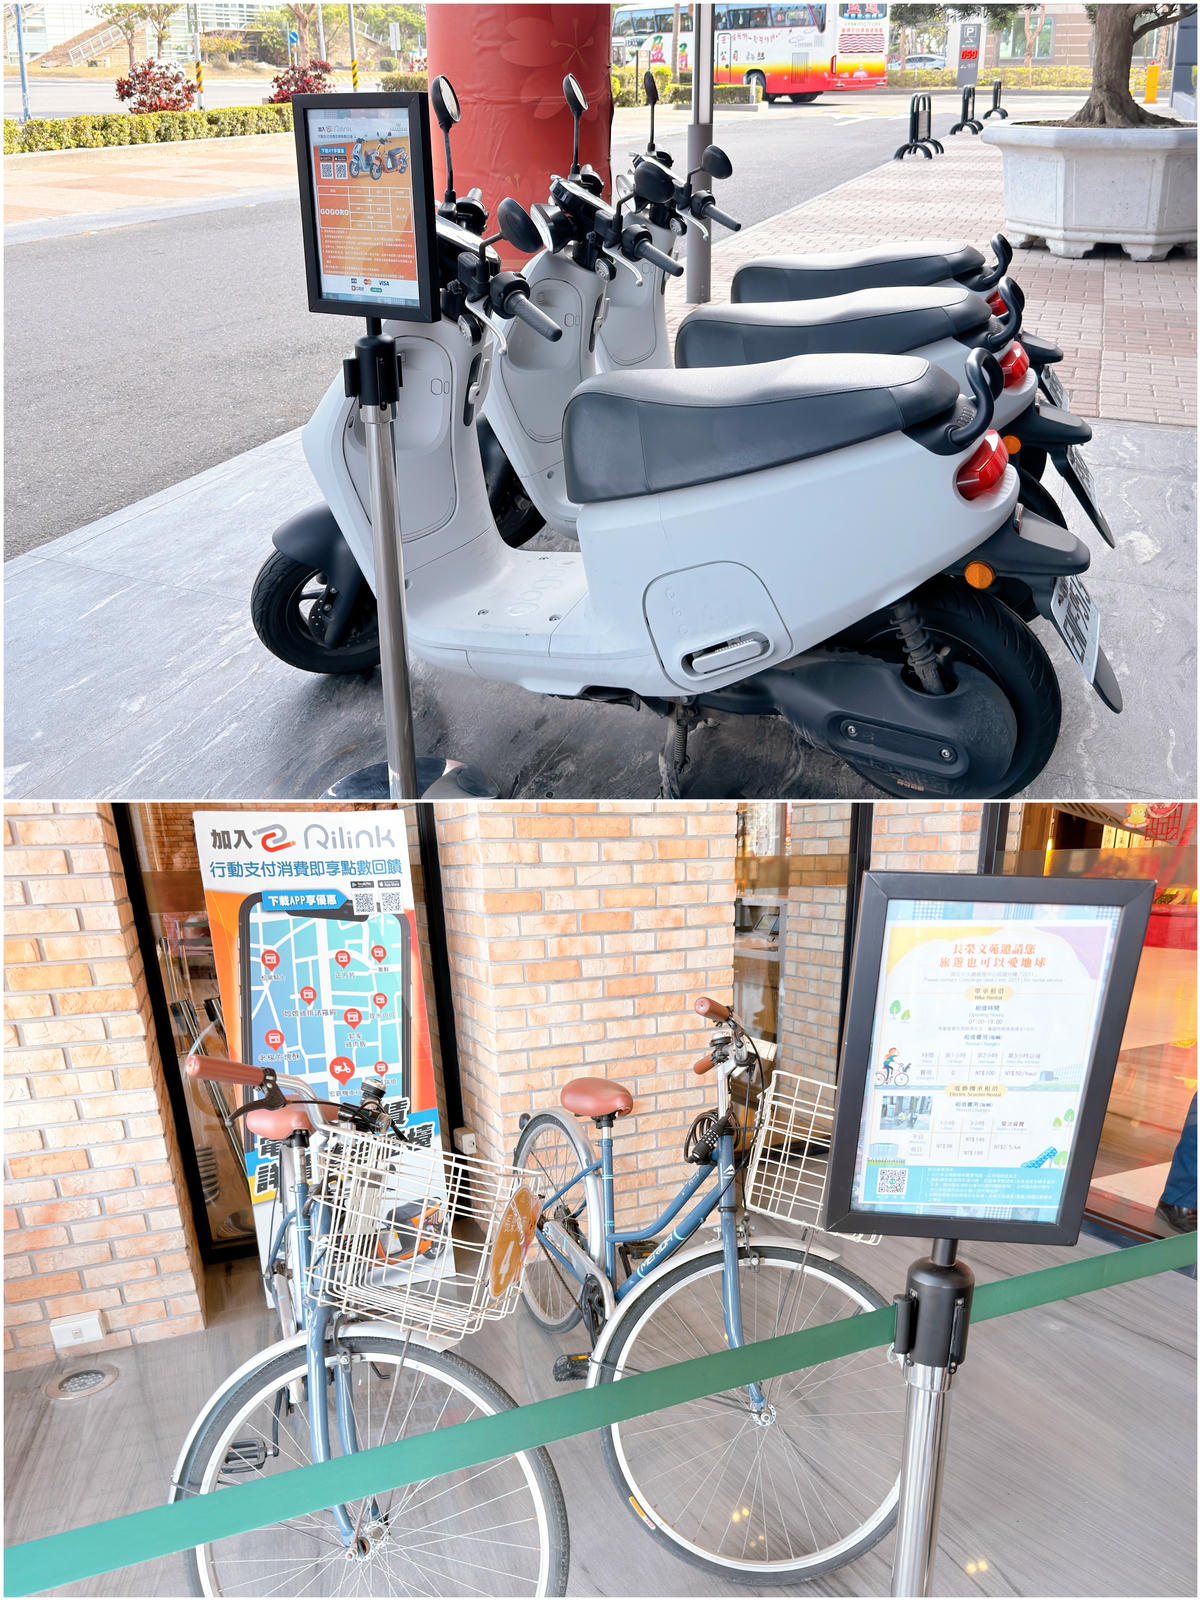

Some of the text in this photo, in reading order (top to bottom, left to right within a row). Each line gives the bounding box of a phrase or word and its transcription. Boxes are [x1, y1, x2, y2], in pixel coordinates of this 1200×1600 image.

[319, 208, 351, 216] GOGORO
[210, 823, 396, 850] 加入 Rilink
[209, 858, 403, 879] 行動支付消費即享點數回饋
[953, 943, 1037, 955] 長榮文苑邀請您
[939, 956, 1047, 969] 旅遊也可以愛地球
[640, 1232, 673, 1272] MERIDA
[498, 1241, 515, 1285] 4
